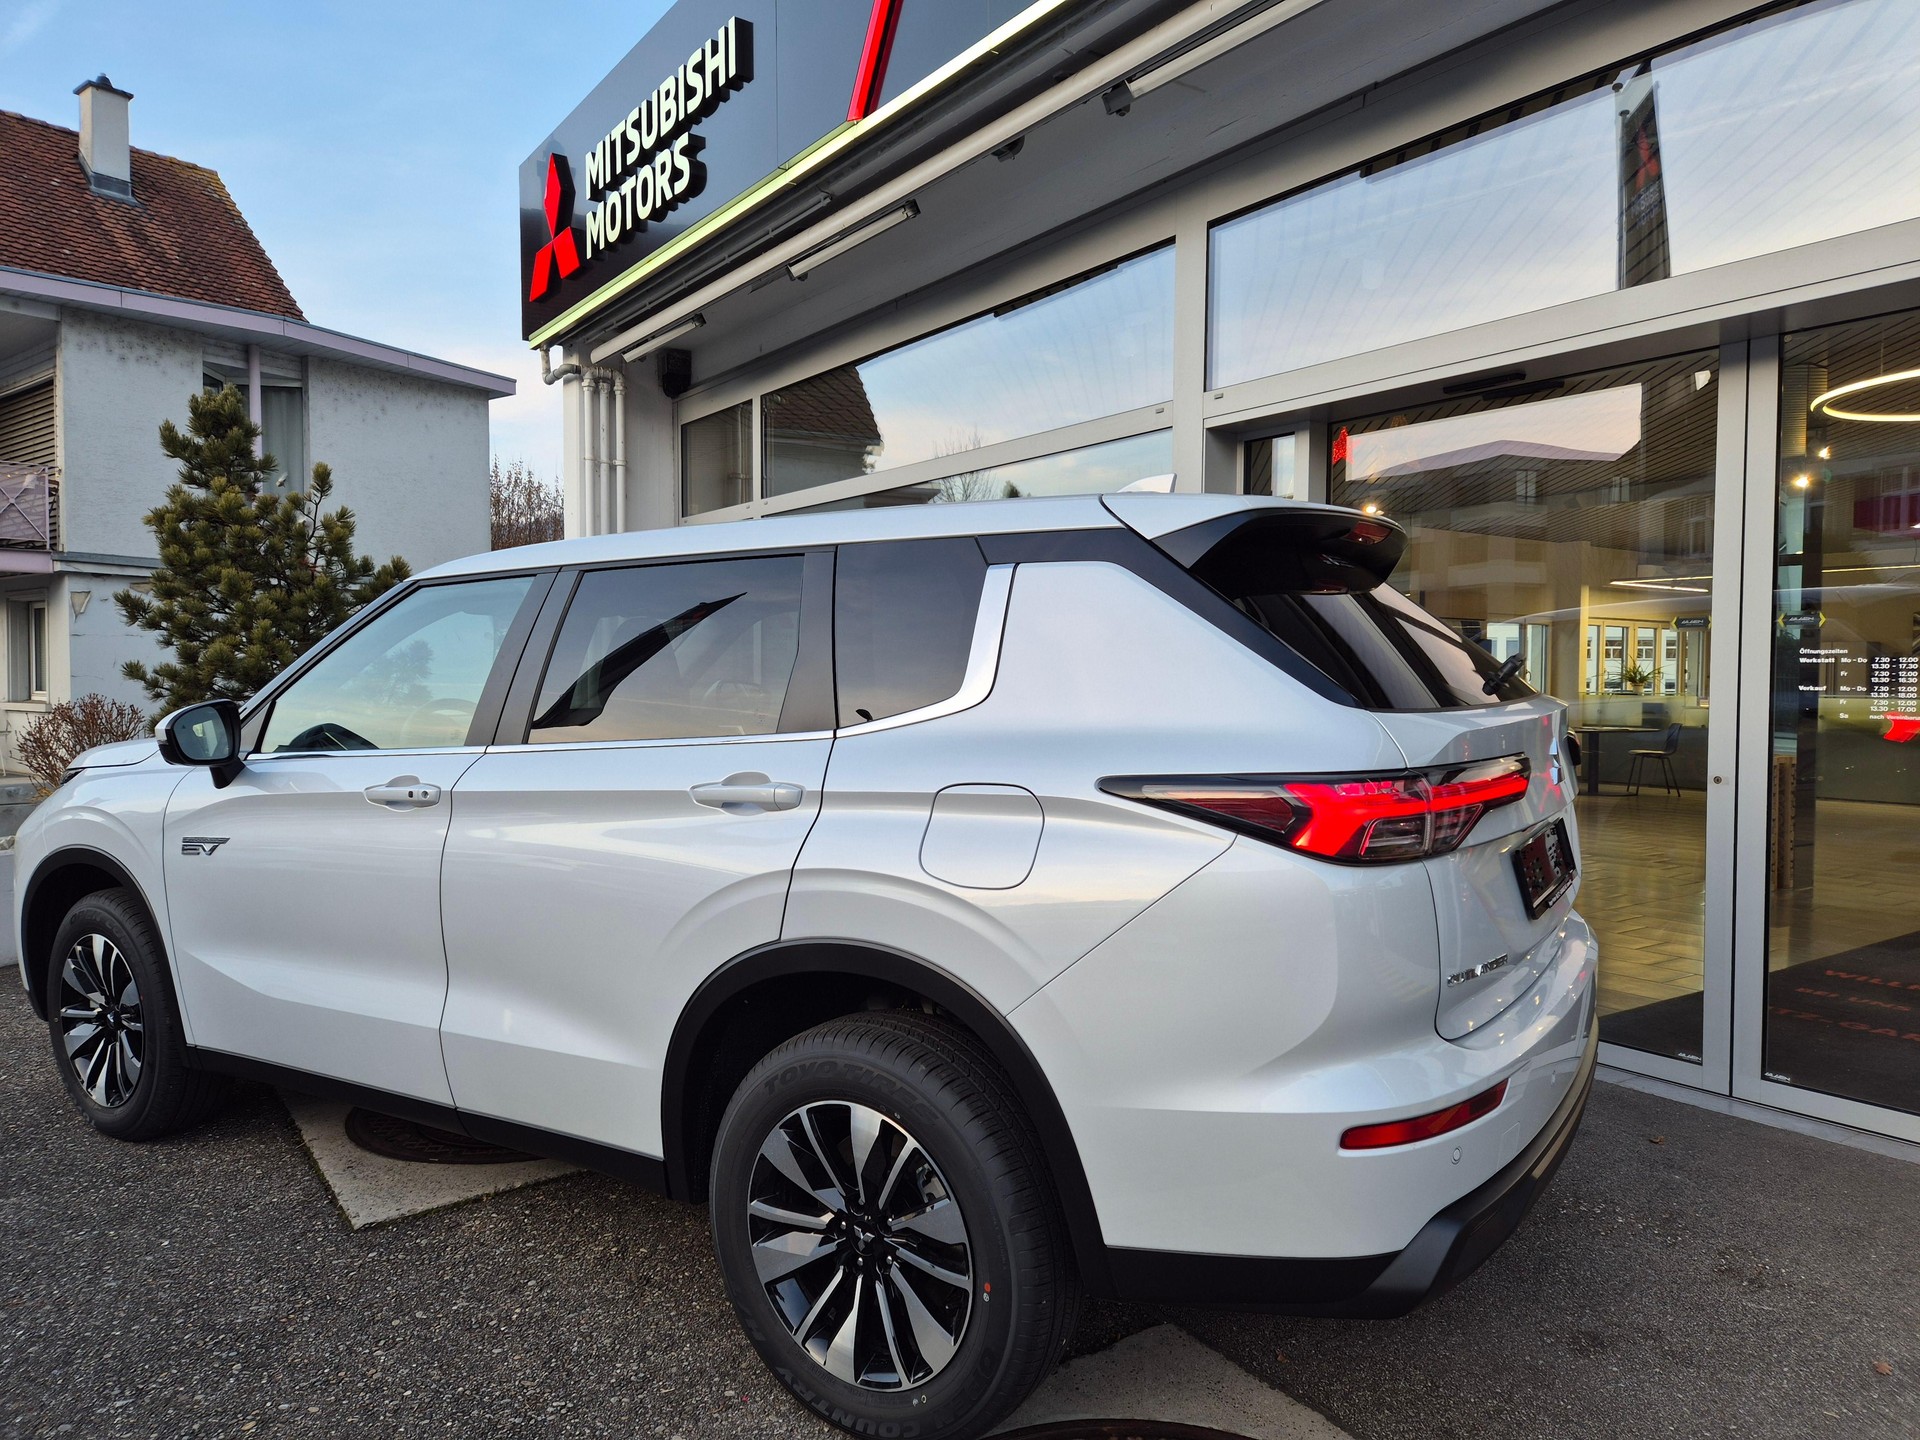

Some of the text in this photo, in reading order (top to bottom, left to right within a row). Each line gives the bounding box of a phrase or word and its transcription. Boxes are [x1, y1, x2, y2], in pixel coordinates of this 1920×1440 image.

[585, 16, 740, 200] MITSUBISHI
[585, 132, 694, 260] MOTORS
[764, 1061, 838, 1096] TOYO
